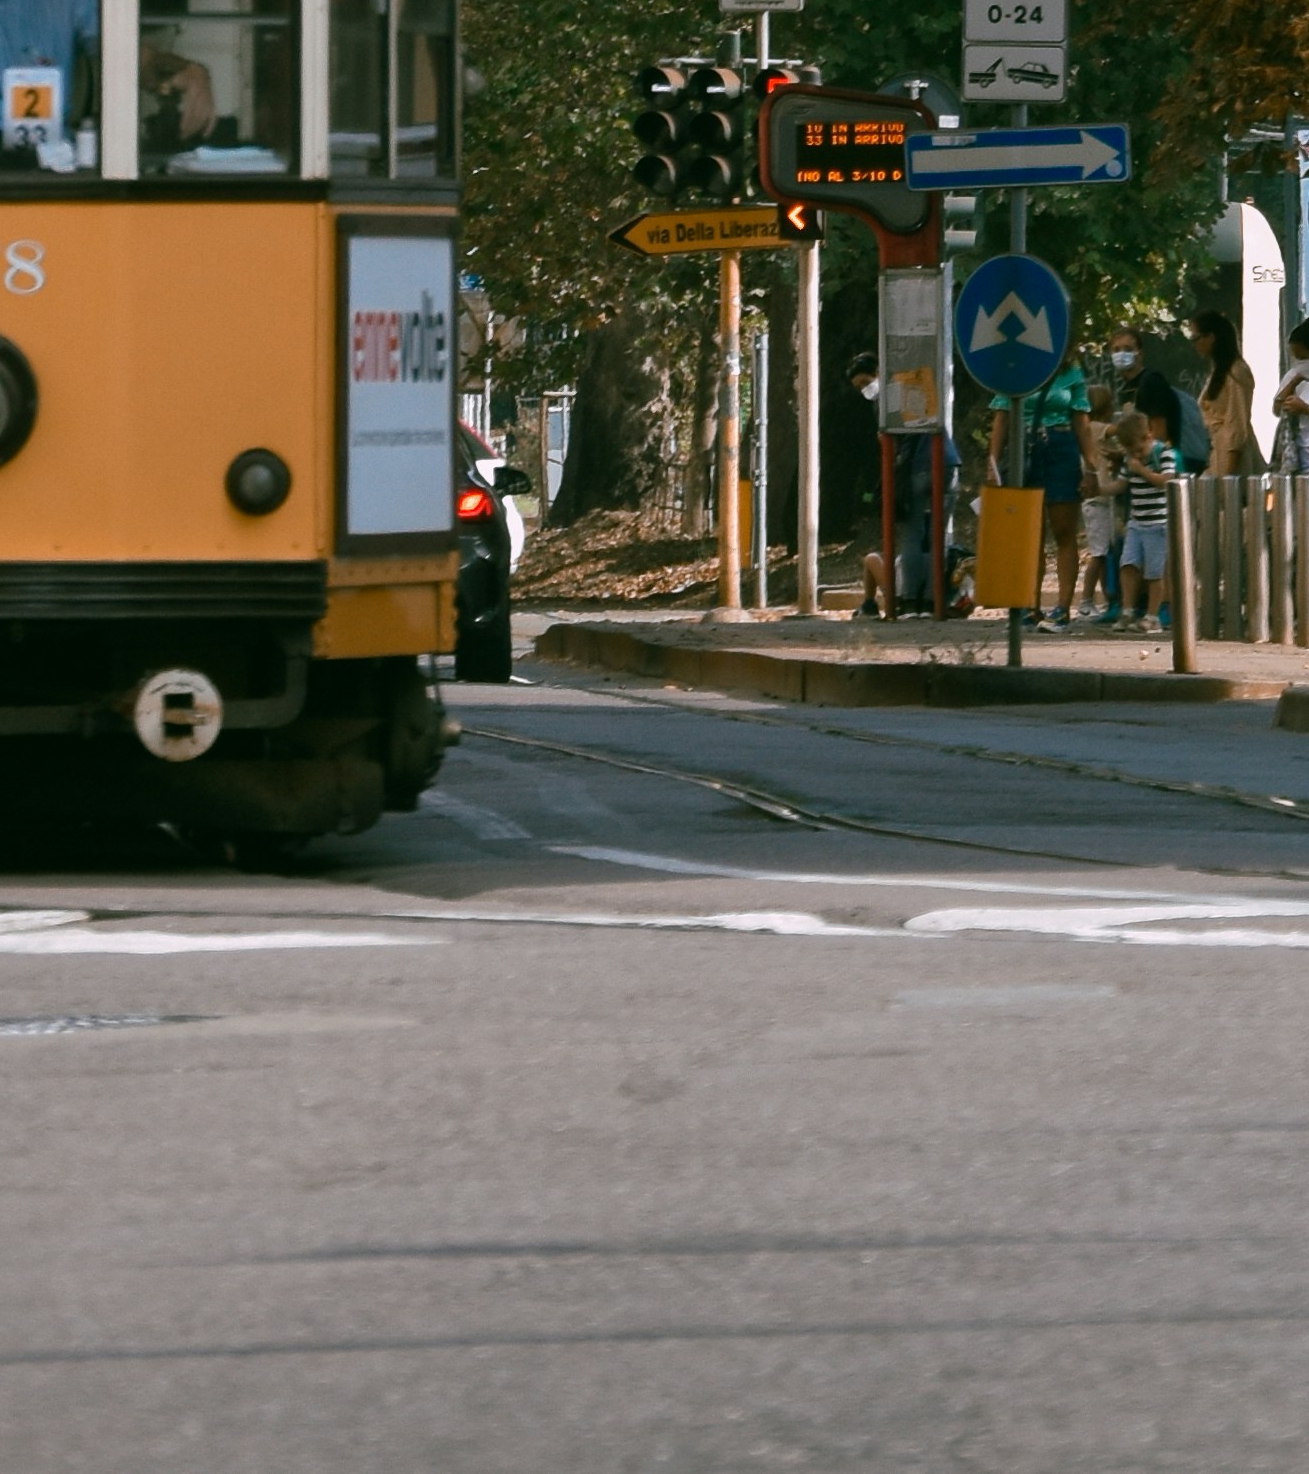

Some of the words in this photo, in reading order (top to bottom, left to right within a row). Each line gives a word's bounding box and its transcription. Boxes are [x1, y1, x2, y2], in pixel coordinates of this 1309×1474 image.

[987, 5, 1044, 24] 0-24
[24, 88, 40, 118] 2
[805, 135, 824, 146] 33
[831, 135, 848, 146] IN
[854, 134, 906, 145] ARRIVO
[828, 170, 845, 183] AL
[852, 170, 886, 182] 3/10
[647, 226, 671, 245] via
[675, 222, 715, 242] Della
